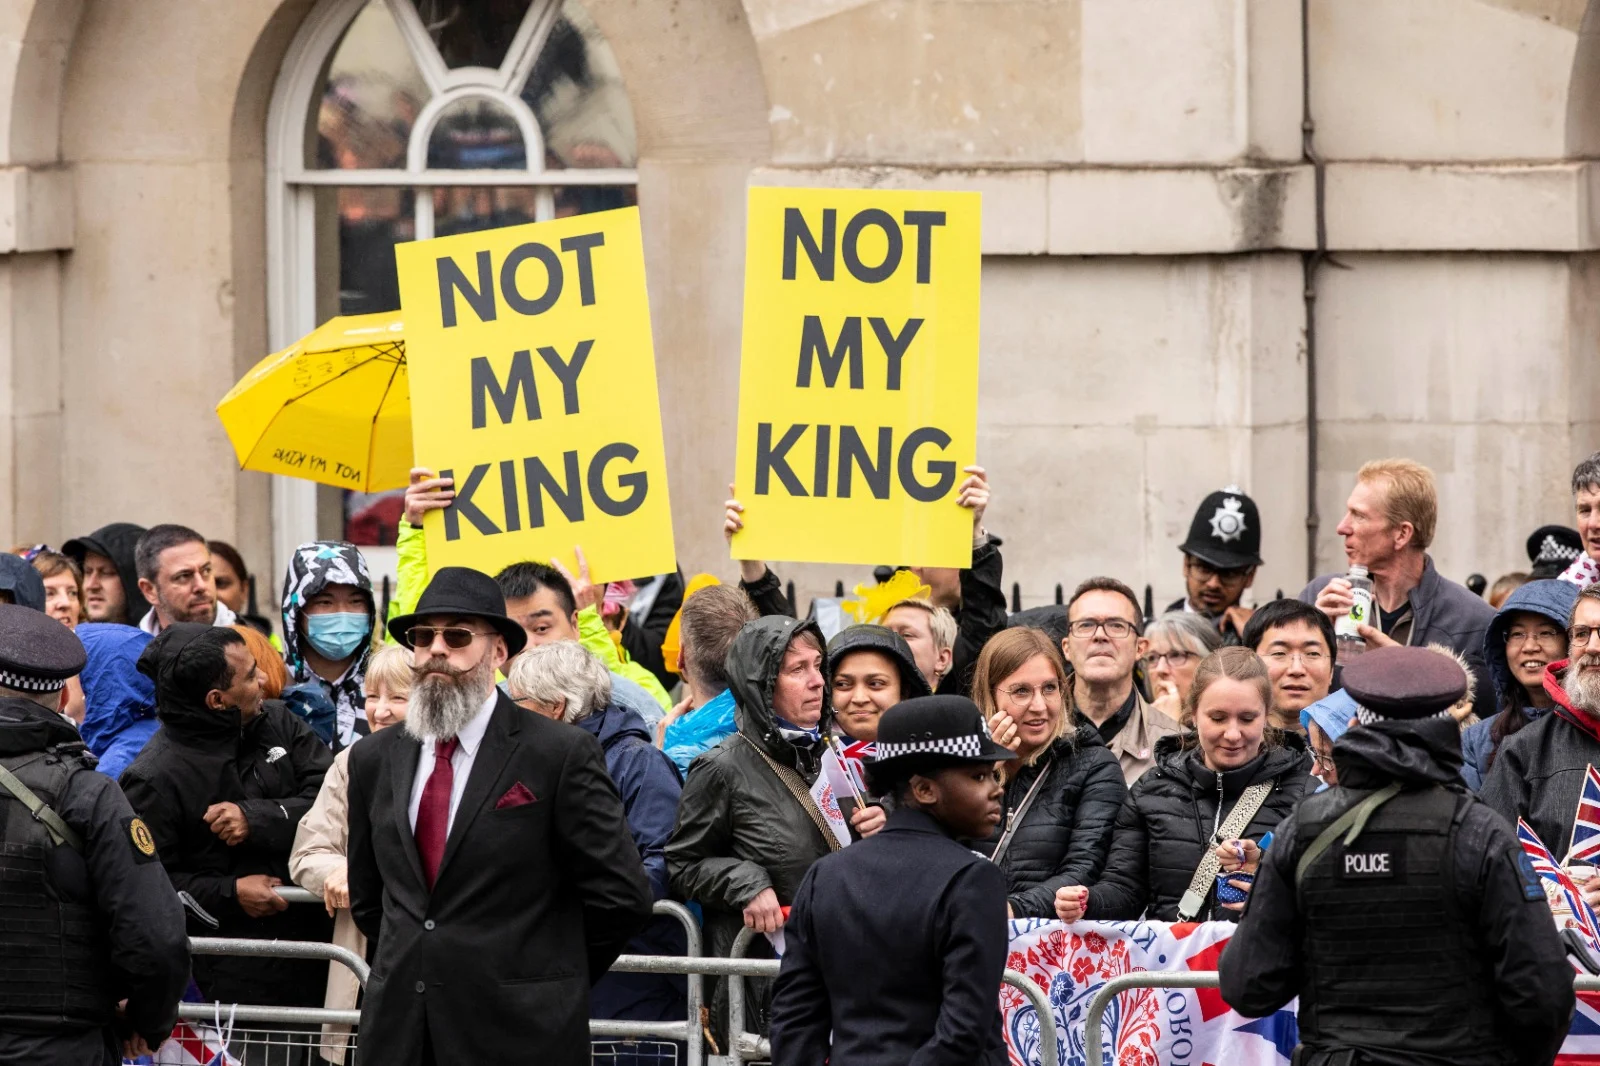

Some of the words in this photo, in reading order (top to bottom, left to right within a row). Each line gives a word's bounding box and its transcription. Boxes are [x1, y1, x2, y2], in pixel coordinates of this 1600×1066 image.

[436, 231, 605, 328] NOT
[782, 208, 946, 284] NOT
[471, 339, 595, 429] MY
[796, 315, 925, 390] MY
[439, 443, 648, 541] KING
[755, 423, 956, 502] KING
[1345, 853, 1390, 873] POLICE
